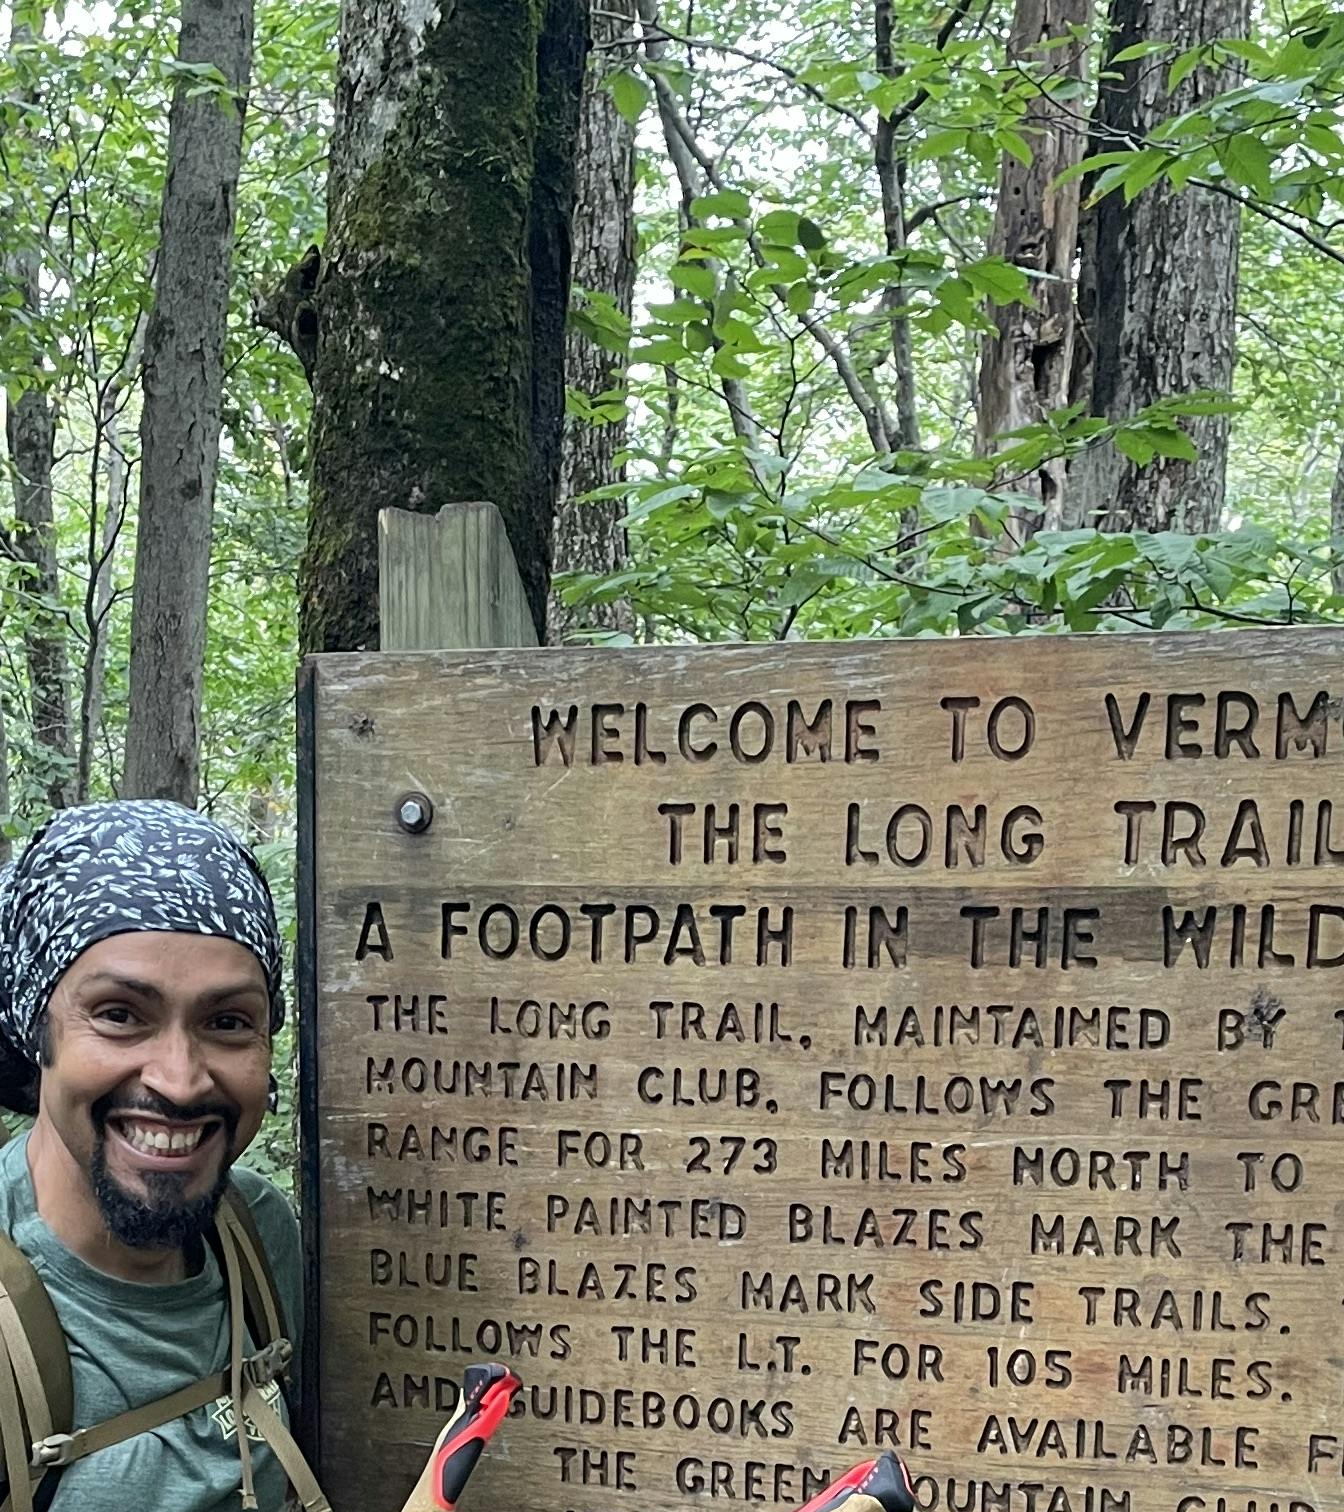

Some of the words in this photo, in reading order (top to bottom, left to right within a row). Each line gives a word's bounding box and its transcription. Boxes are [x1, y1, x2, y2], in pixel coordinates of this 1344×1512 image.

[531, 698, 882, 766] WELCOME
[940, 696, 1037, 762] TO
[658, 802, 788, 866] THE
[845, 802, 1045, 869] LONG
[355, 902, 394, 963] A
[440, 902, 794, 968] FOOTPATH
[842, 905, 909, 969] IN
[960, 905, 1101, 970] THE
[365, 995, 448, 1035] THE
[490, 997, 611, 1039] LONG
[854, 1005, 1171, 1050] MAINTAINED
[1217, 1007, 1287, 1051] BY
[365, 1056, 599, 1103] MOUNTAIN
[818, 1072, 1056, 1117] FOLLOWS
[1104, 1078, 1203, 1122] THE
[366, 1123, 520, 1168] RANGE
[557, 1130, 645, 1172] FOR
[685, 1136, 779, 1175] 273
[820, 1138, 968, 1186] MILES
[1012, 1144, 1190, 1192] NORTH
[1236, 1151, 1305, 1194] TO
[365, 1186, 507, 1232] WHITE
[546, 1194, 748, 1242] PAINTED
[788, 1203, 985, 1252] BLAZES
[1030, 1213, 1182, 1260] MARK
[1225, 1221, 1328, 1267] THE
[369, 1248, 479, 1294] BLUE
[518, 1256, 698, 1304] BLAZES
[741, 1268, 878, 1315] MARK
[919, 1279, 1035, 1325] SIDE
[1078, 1285, 1291, 1335] TRAILS.
[369, 1312, 571, 1361] FOLLOWS
[611, 1325, 698, 1369] THE
[737, 1332, 813, 1377] L.T.
[853, 1339, 945, 1383] FOR
[986, 1344, 1074, 1389] 105
[1118, 1354, 1293, 1403] MILES.
[370, 1372, 460, 1412] AND
[838, 1406, 933, 1451] ARE
[977, 1413, 1259, 1469] AVAILABLE
[554, 1447, 636, 1492] THE
[676, 1456, 831, 1504] GREEN
